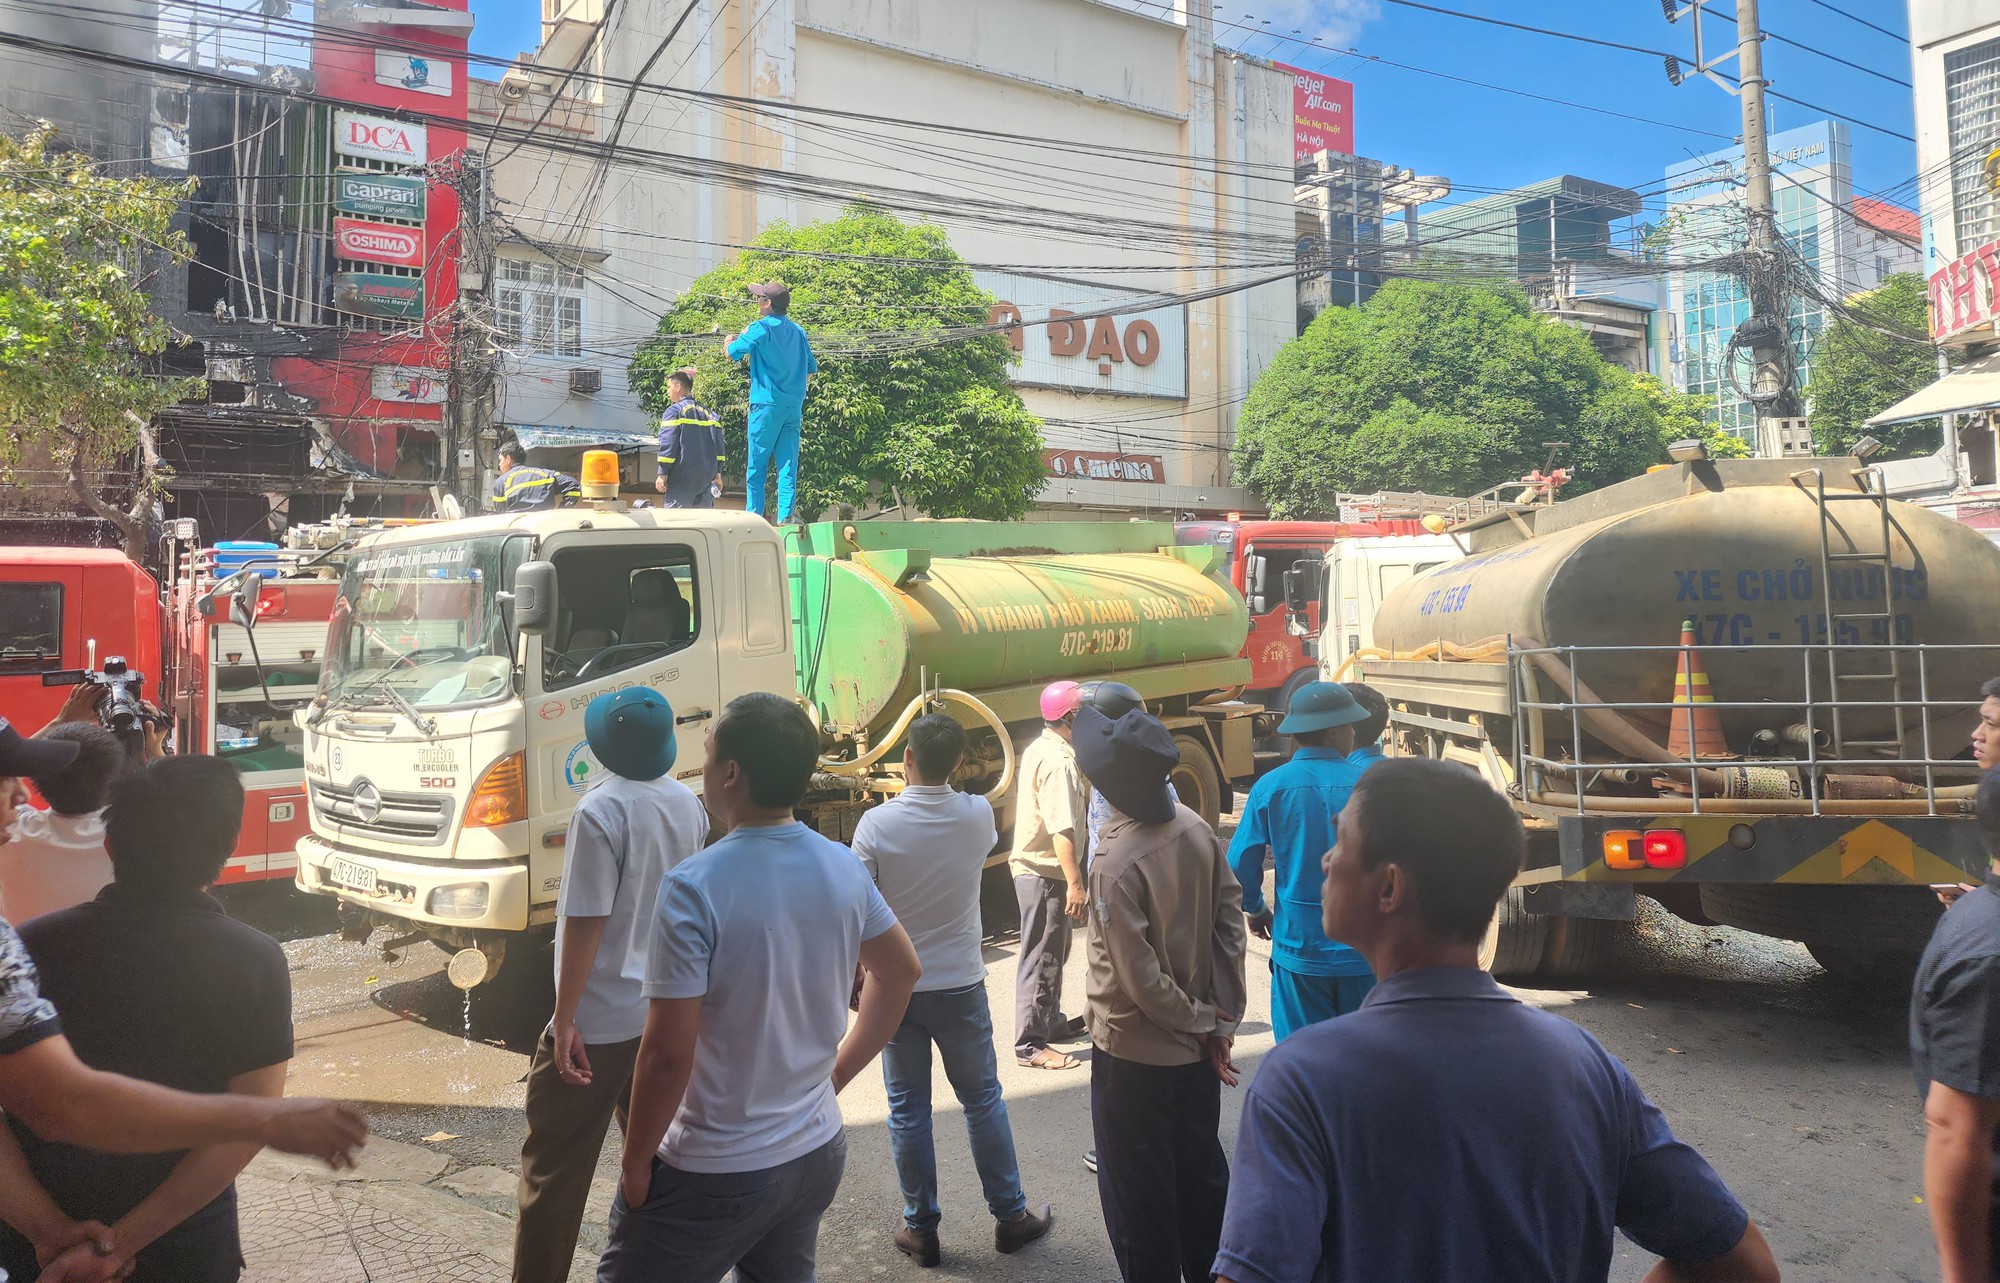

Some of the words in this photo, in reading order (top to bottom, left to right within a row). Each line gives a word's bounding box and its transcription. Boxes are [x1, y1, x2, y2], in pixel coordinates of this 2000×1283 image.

[1294, 75, 1325, 95] ietjet
[1304, 94, 1341, 113] Air.com
[349, 121, 413, 152] DCA
[1297, 131, 1308, 143] HÀ
[1805, 141, 1825, 158] NAM
[354, 202, 385, 213] pumping
[385, 206, 408, 214] power
[349, 233, 408, 252] OSHIMA
[1047, 309, 1160, 375] ĐẠO
[1674, 570, 1724, 602] XE
[1736, 558, 1813, 602] CHỞ
[976, 600, 1047, 633] THÀNH
[1084, 597, 1140, 625] XANH,
[1139, 596, 1189, 626] SẠCH,
[1185, 594, 1216, 622] ĐẸP
[650, 667, 680, 687] FG
[418, 748, 455, 765] TURBO
[420, 777, 456, 789] 500
